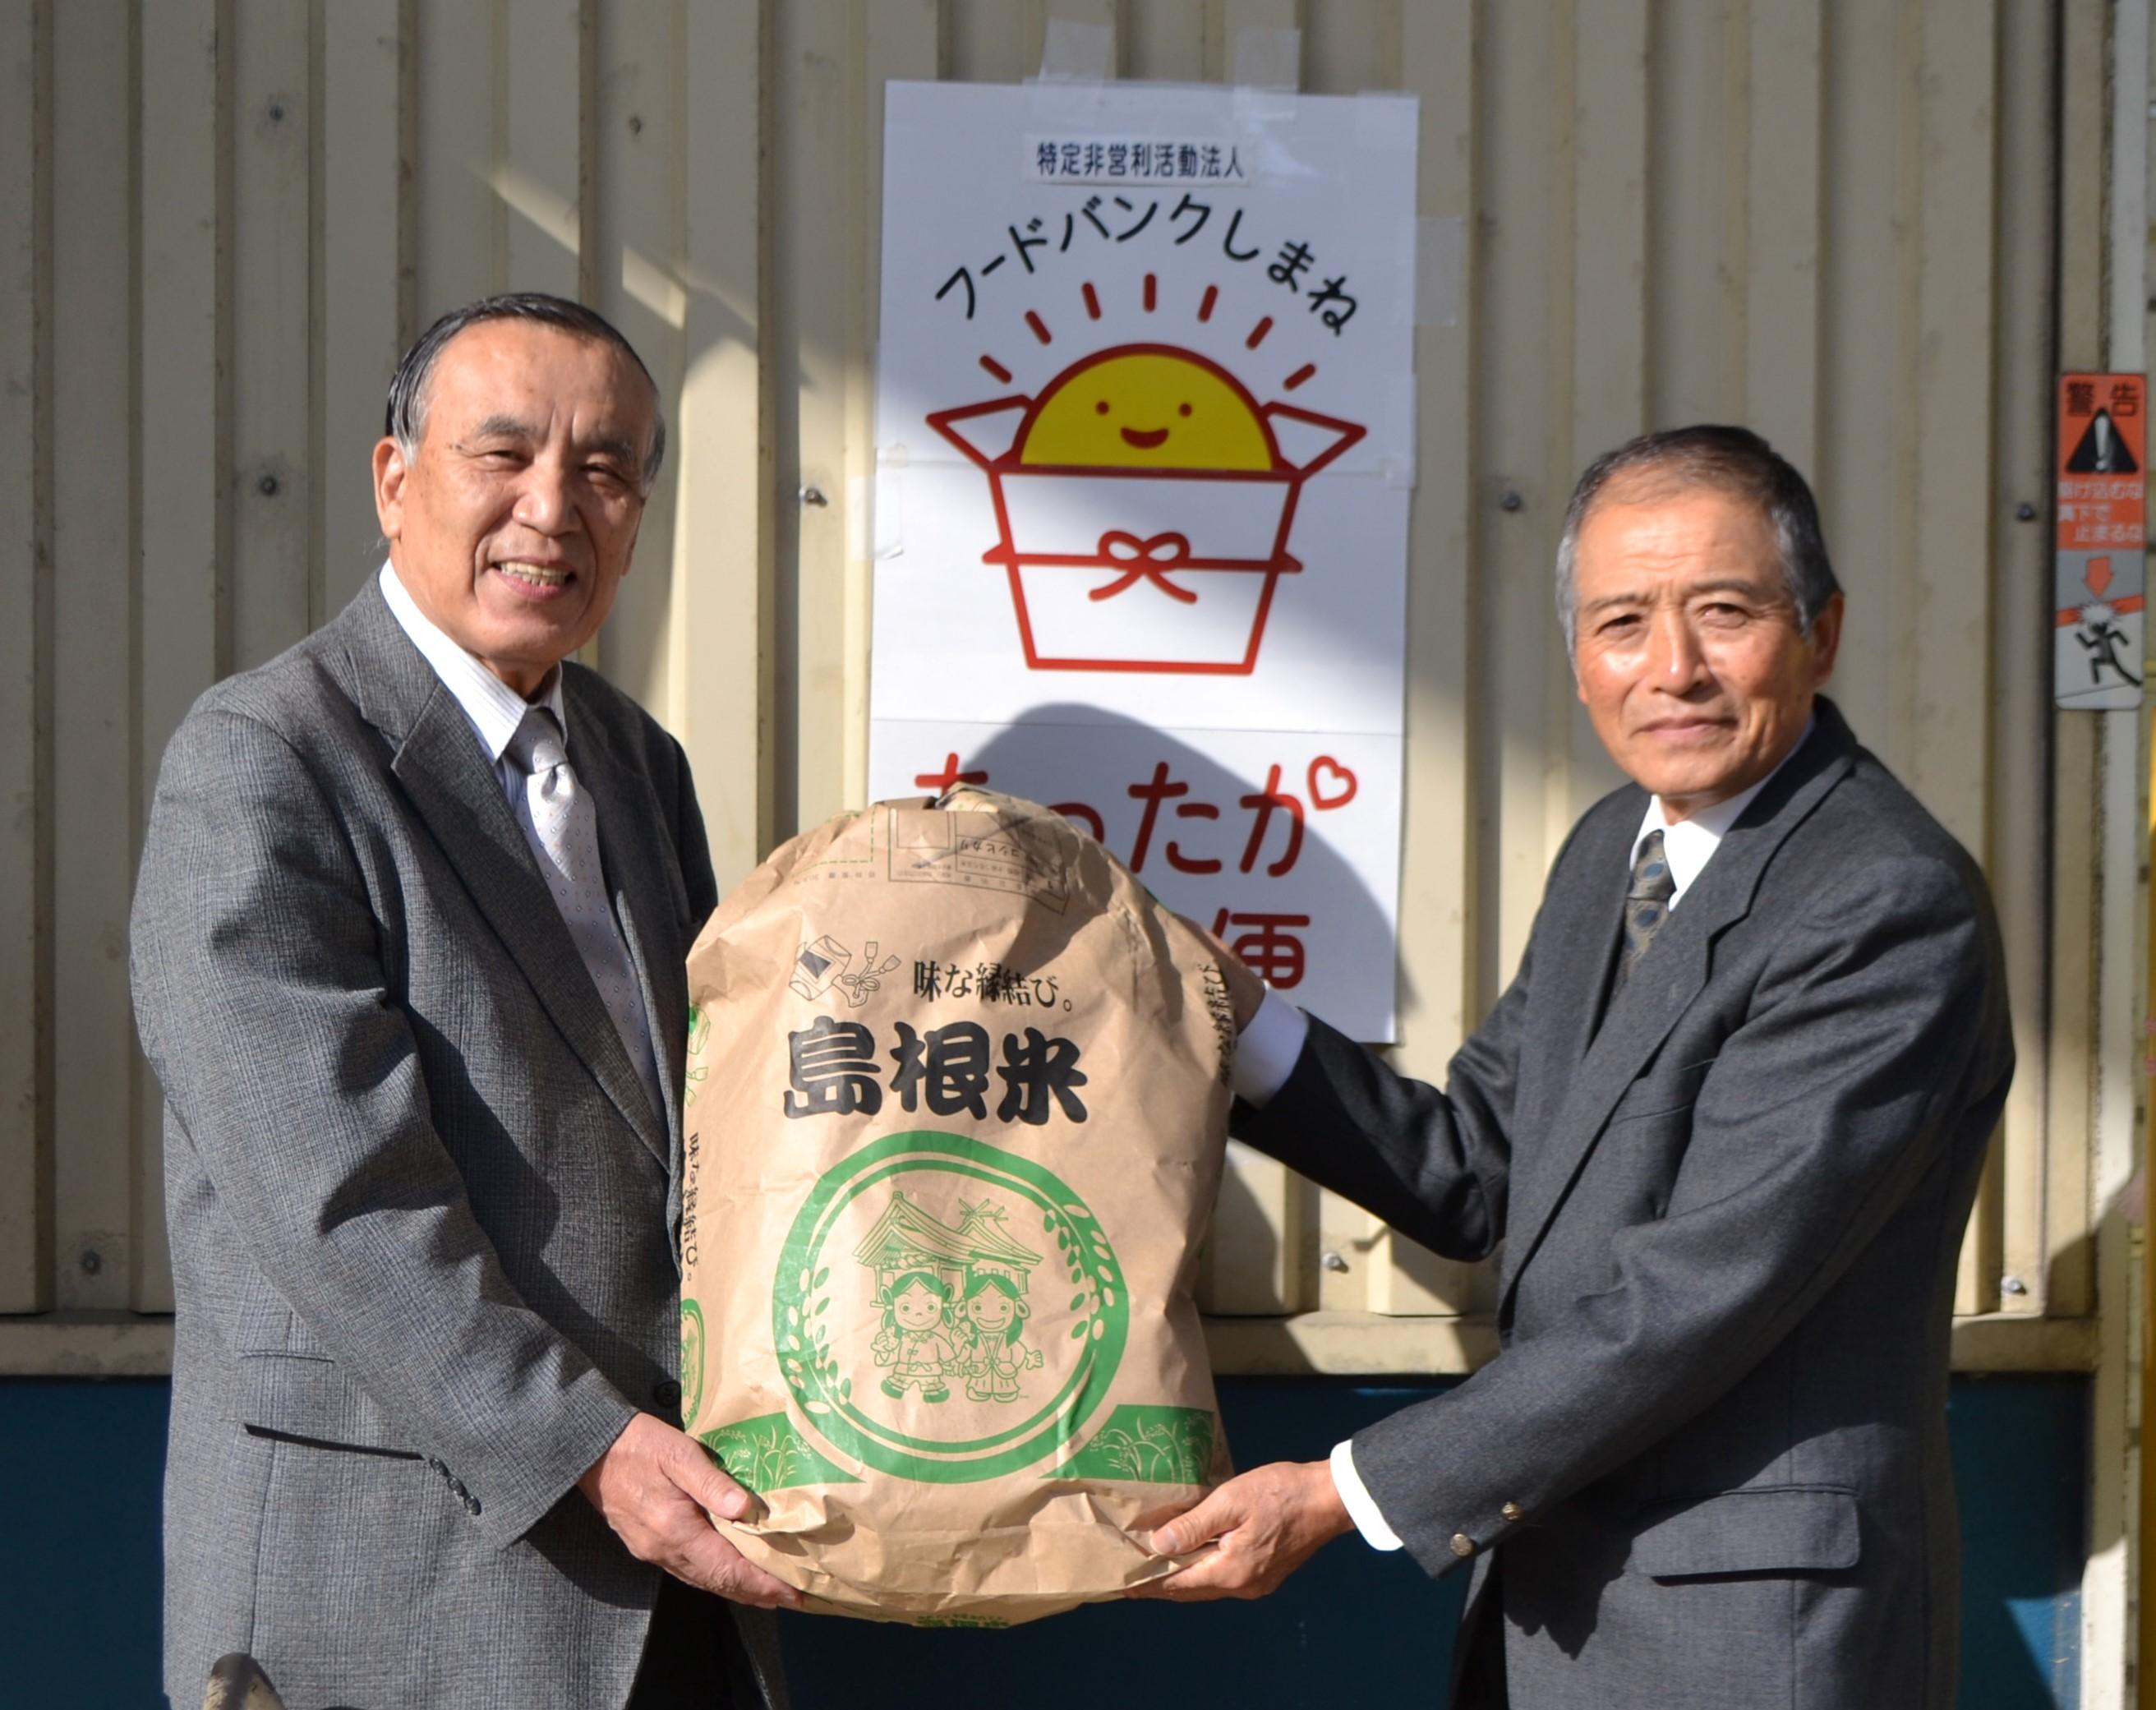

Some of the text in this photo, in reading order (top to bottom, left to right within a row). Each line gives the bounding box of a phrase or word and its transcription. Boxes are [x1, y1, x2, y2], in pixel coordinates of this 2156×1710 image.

[1036, 141, 1245, 179] 特定非営利活動法人
[935, 193, 1358, 335] フードバンクしまね
[2066, 381, 2139, 417] 警告
[914, 753, 1305, 876] ったか
[912, 959, 1073, 1012] 味な縁結び。
[783, 1015, 1088, 1126] 島根米
